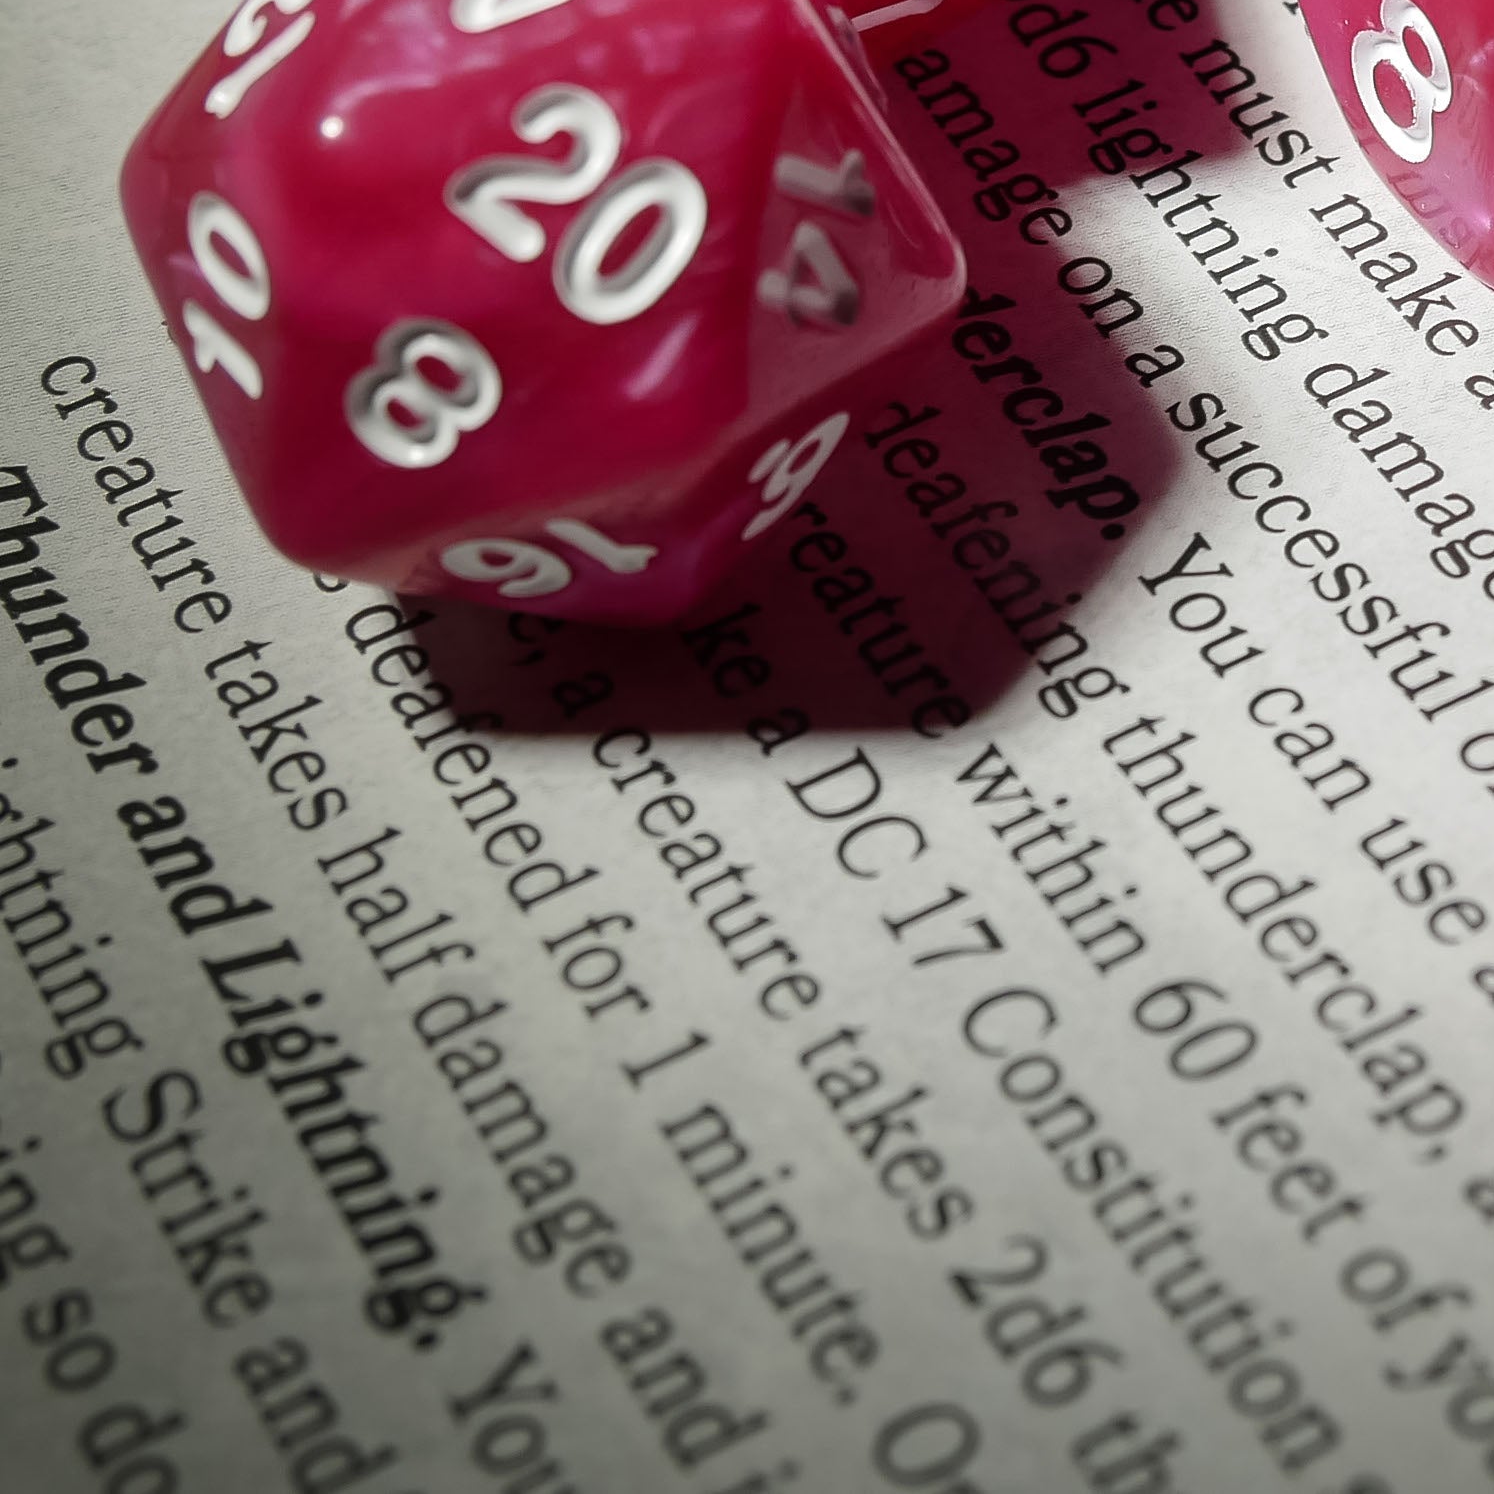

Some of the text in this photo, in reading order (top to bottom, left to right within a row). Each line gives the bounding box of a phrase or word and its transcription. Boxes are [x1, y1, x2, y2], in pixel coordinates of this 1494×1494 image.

[181, 190, 272, 400] 10
[444, 82, 708, 326] 20
[894, 49, 1073, 247] amage
[1058, 256, 1146, 340] on
[1124, 343, 1187, 389] a
[1072, 79, 1331, 363] lightning
[1180, 39, 1341, 188] must
[1309, 192, 1480, 358] make
[344, 316, 503, 470] 8
[345, 604, 600, 913] deafened
[864, 401, 1131, 719] deafening
[1103, 715, 1466, 1166] thunderclap,
[1139, 534, 1268, 679] You
[1249, 686, 1373, 813] can
[1361, 818, 1488, 947] use
[0, 464, 159, 774] Thunder
[118, 795, 274, 936] and
[200, 937, 491, 1354] Lightning.
[41, 355, 232, 634] creature
[203, 639, 348, 831] takes
[317, 826, 476, 984] half
[412, 991, 633, 1300] damage
[600, 1306, 773, 1471] and
[543, 912, 652, 1020] for
[551, 671, 614, 721] a
[592, 726, 821, 1021] creature
[799, 1024, 976, 1242] takes
[950, 1235, 1126, 1410] 2d6
[621, 1031, 711, 1090] 1
[790, 501, 970, 739] reature
[956, 743, 1148, 976] within
[1133, 978, 1259, 1082] 60
[1212, 1082, 1370, 1244] feet
[1340, 1247, 1477, 1334] of
[746, 708, 811, 759] a
[786, 746, 929, 879] DC
[881, 886, 1005, 968] 17
[962, 986, 1344, 1476] Constitution
[22, 1287, 117, 1394] so
[102, 1070, 270, 1329] Strike
[232, 1336, 398, 1494] and
[662, 1102, 882, 1406] minute.
